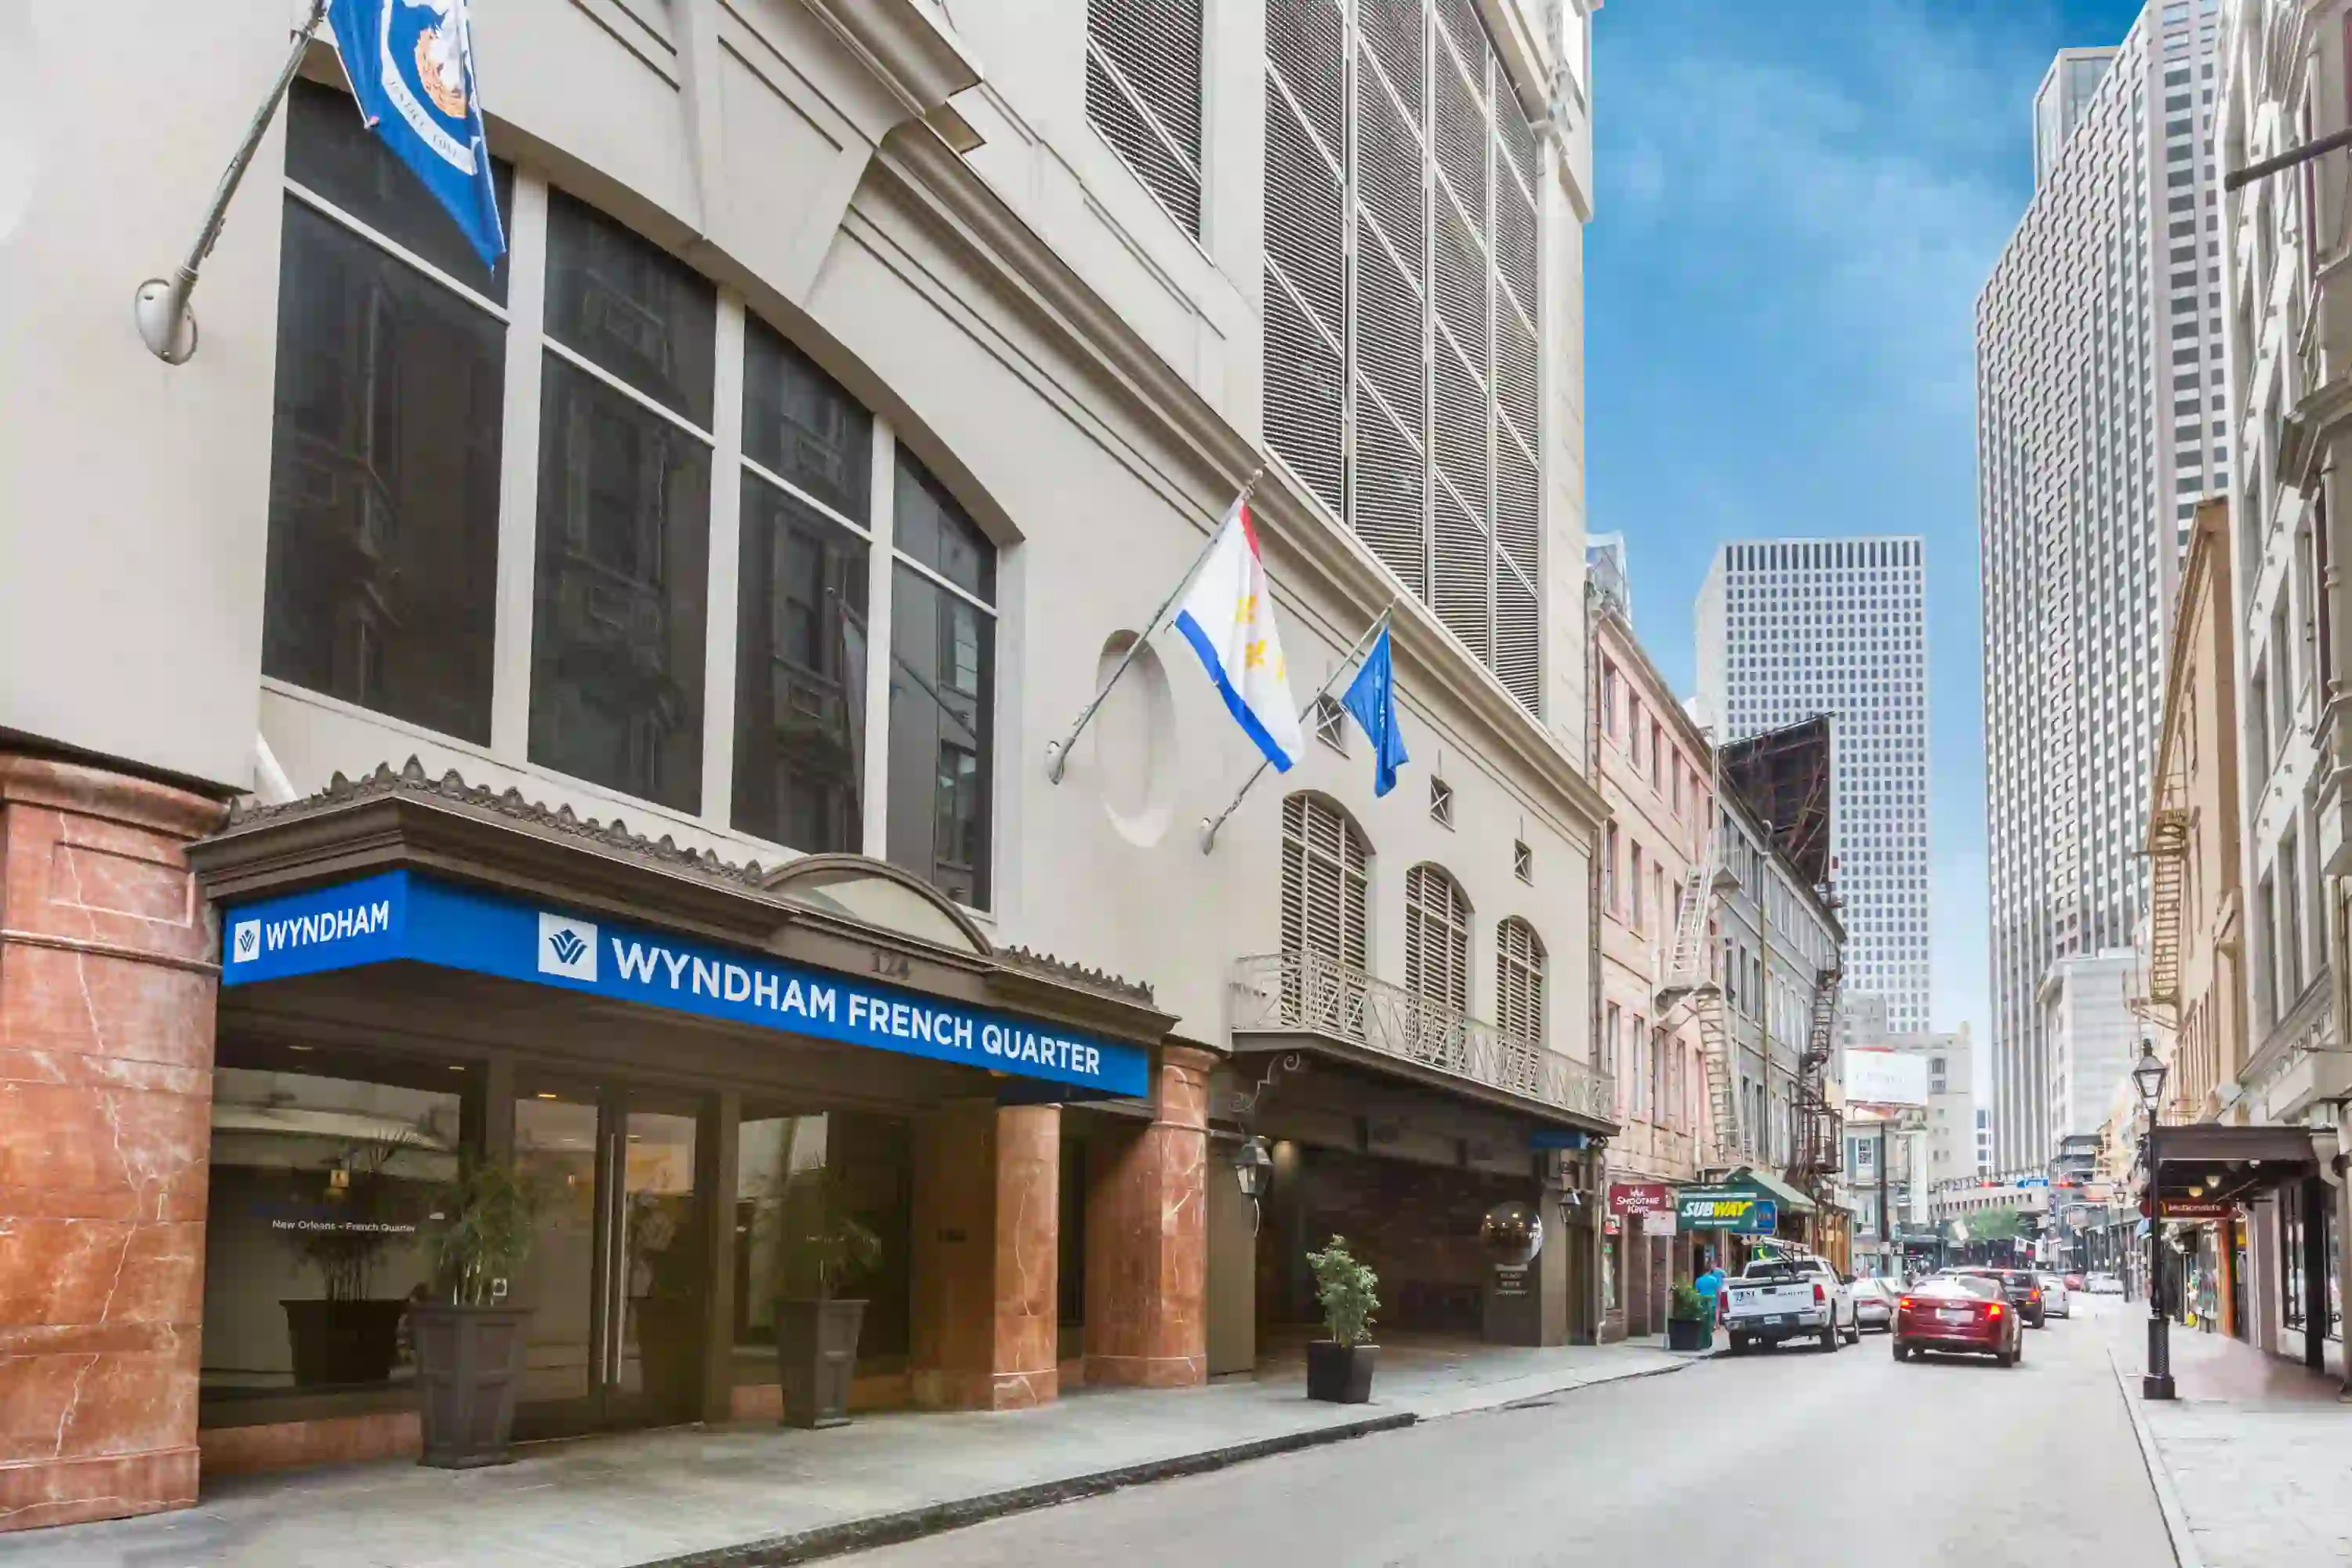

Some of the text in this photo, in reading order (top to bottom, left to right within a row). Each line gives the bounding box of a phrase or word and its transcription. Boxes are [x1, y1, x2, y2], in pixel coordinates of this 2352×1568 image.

[266, 900, 389, 951] WYNDHAM
[612, 938, 1099, 1075] WYNDHAM FRENCH QUARTER
[272, 1219, 296, 1229] New
[298, 1220, 336, 1231] Orleans
[346, 1222, 379, 1232] French
[381, 1224, 416, 1232] Quarter
[1680, 1200, 1754, 1218] SUBWAY
